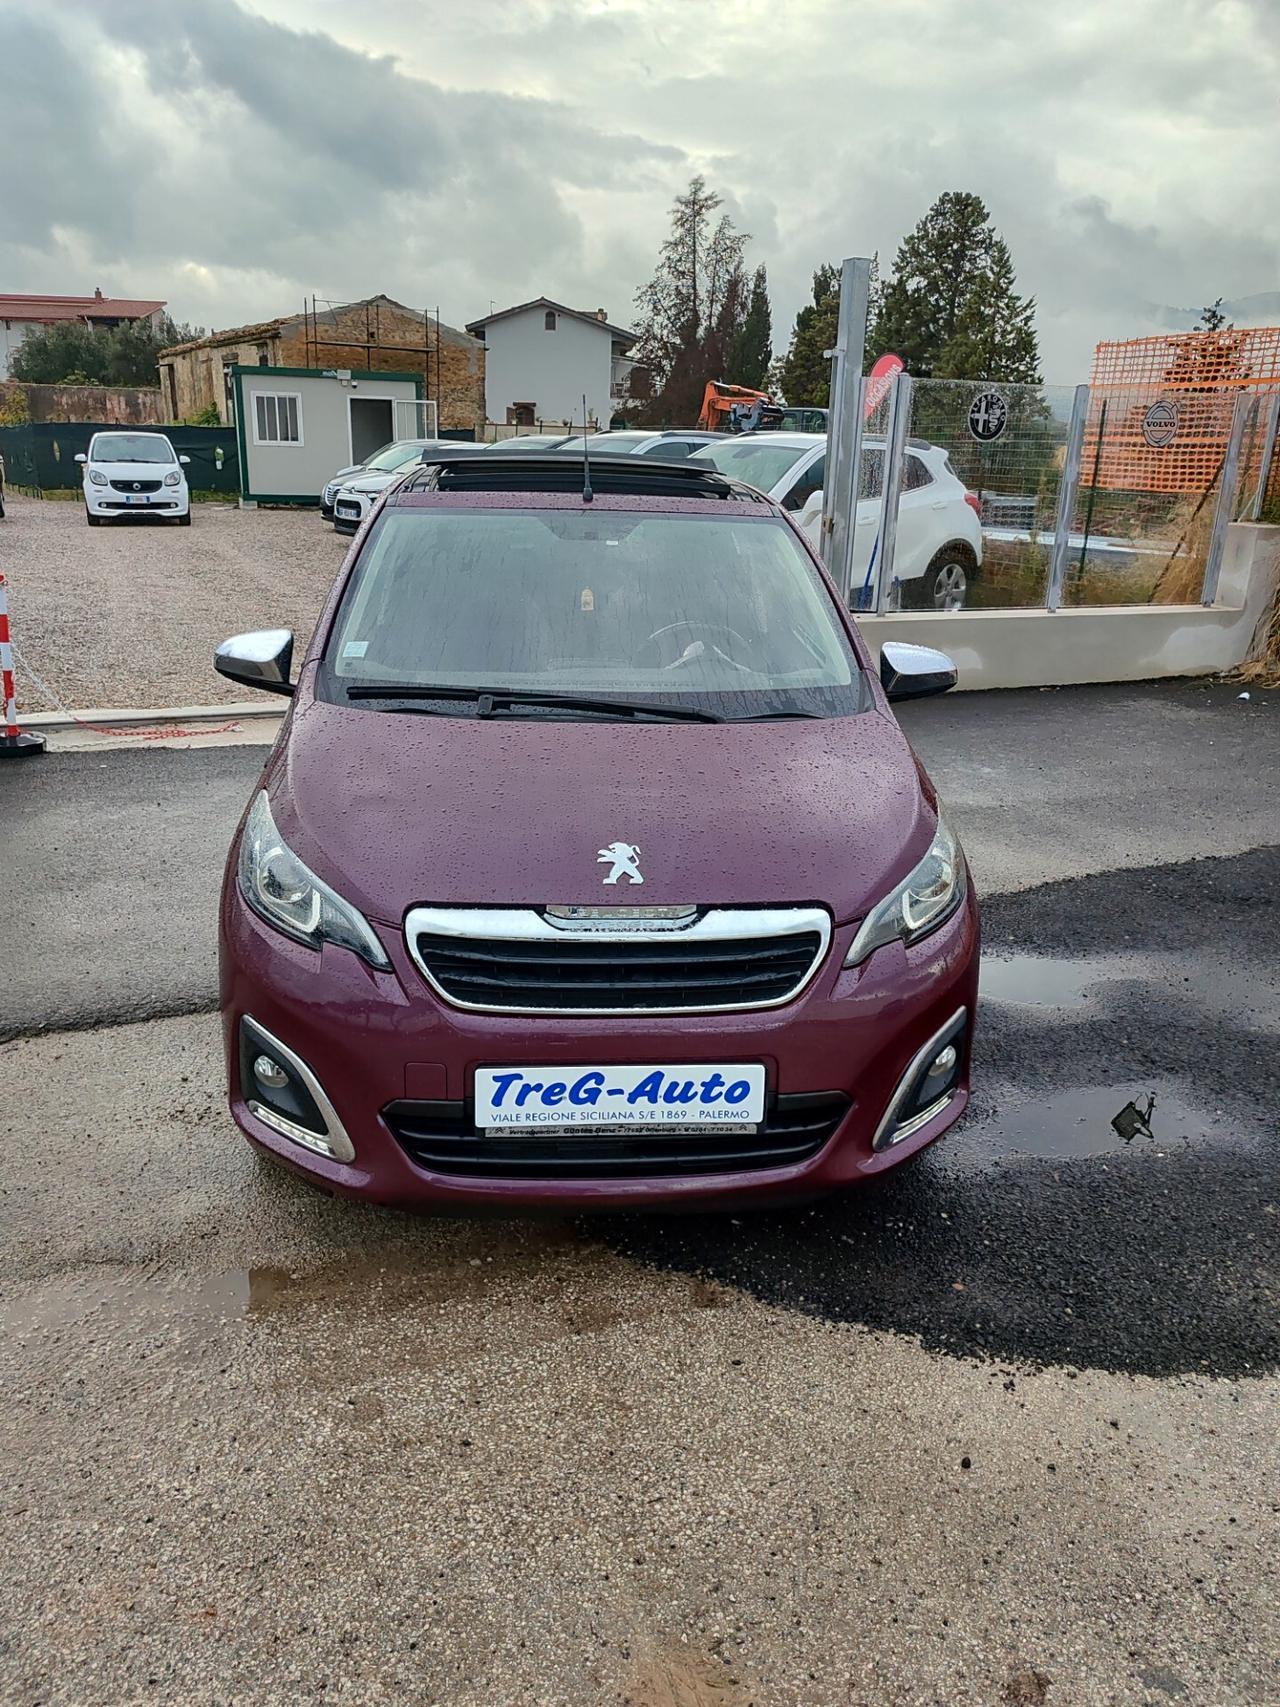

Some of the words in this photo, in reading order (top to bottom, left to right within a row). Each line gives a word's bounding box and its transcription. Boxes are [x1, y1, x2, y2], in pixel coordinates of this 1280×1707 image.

[866, 363, 901, 407] OCCASIONS
[491, 1070, 751, 1108] TreG-Auto
[491, 1113, 521, 1123] VIALE
[525, 1112, 576, 1122] REGIONE
[580, 1111, 635, 1121] SICILIANA
[638, 1110, 656, 1120] S/E
[660, 1110, 687, 1120] 1869
[699, 1110, 750, 1120] PALERMO
